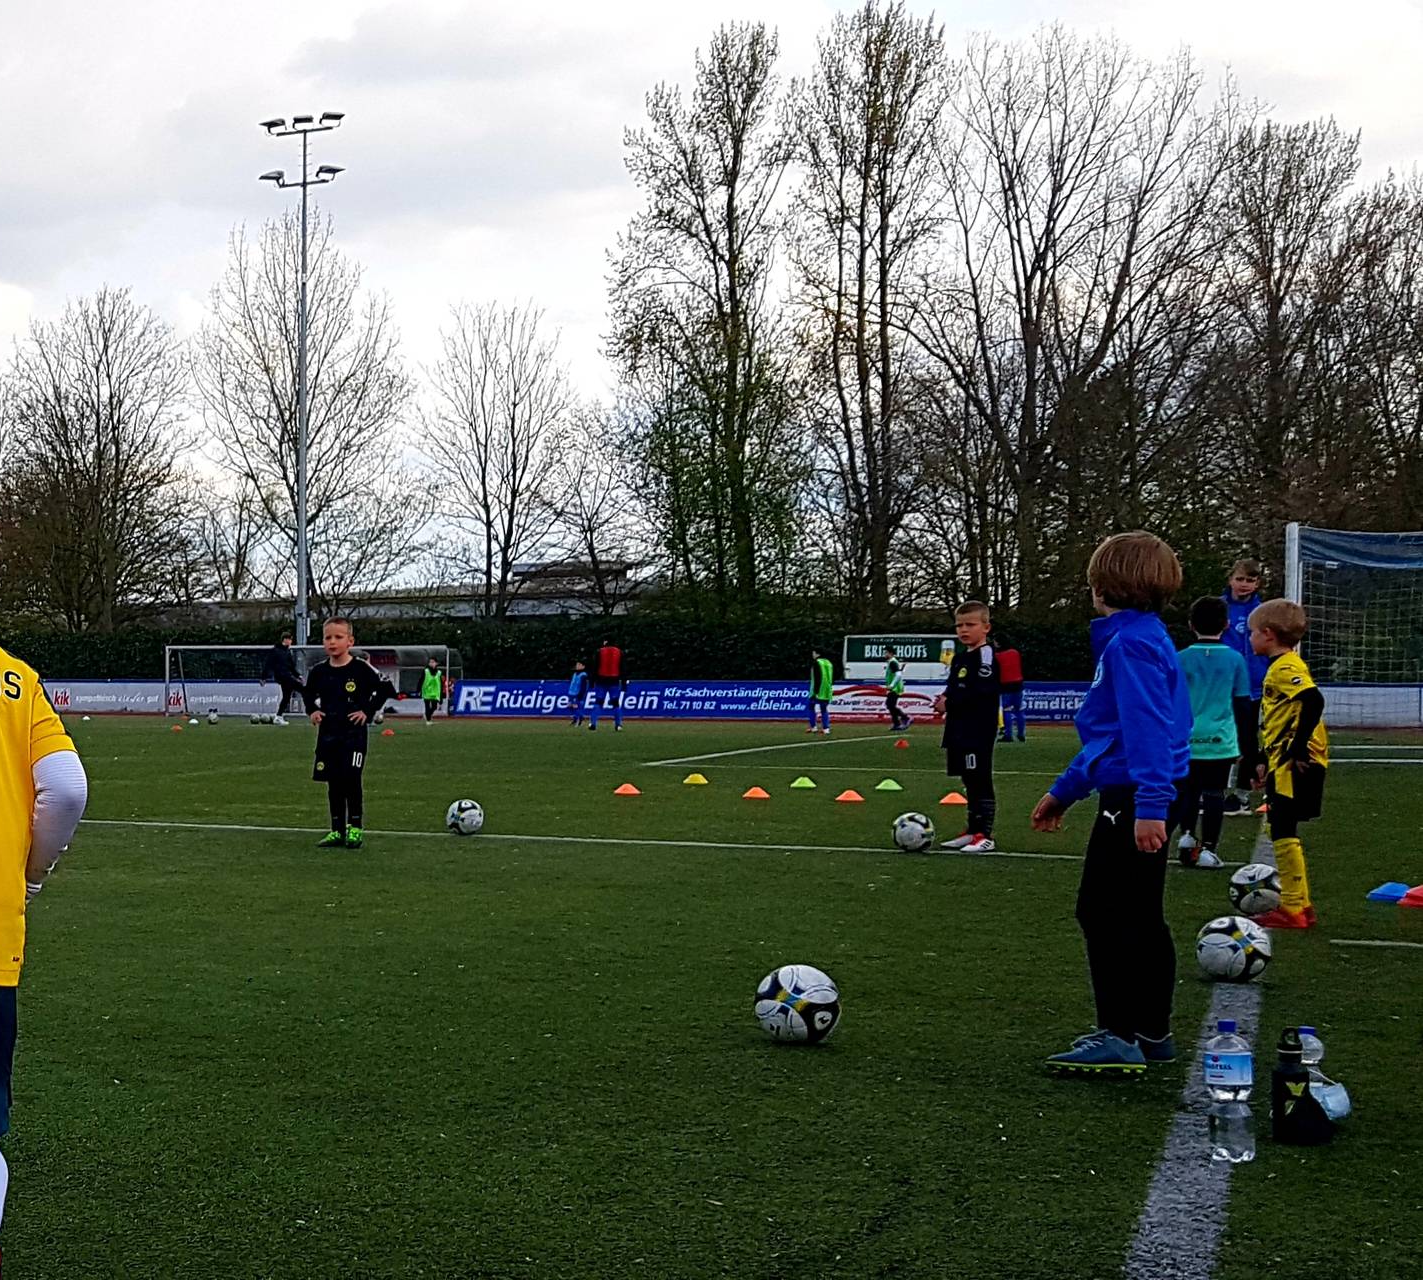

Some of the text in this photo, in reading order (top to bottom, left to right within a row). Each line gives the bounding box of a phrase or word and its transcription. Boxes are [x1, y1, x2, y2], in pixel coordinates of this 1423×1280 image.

[54, 690, 70, 705] kik
[456, 685, 496, 711] RE
[664, 686, 808, 699] Kfz-Sachverständigenbüro
[496, 690, 569, 713] Rüdige
[663, 699, 806, 711] Tel. 71 10 82 www.elblein.de
[351, 752, 363, 768] 10
[965, 753, 977, 770] 10
